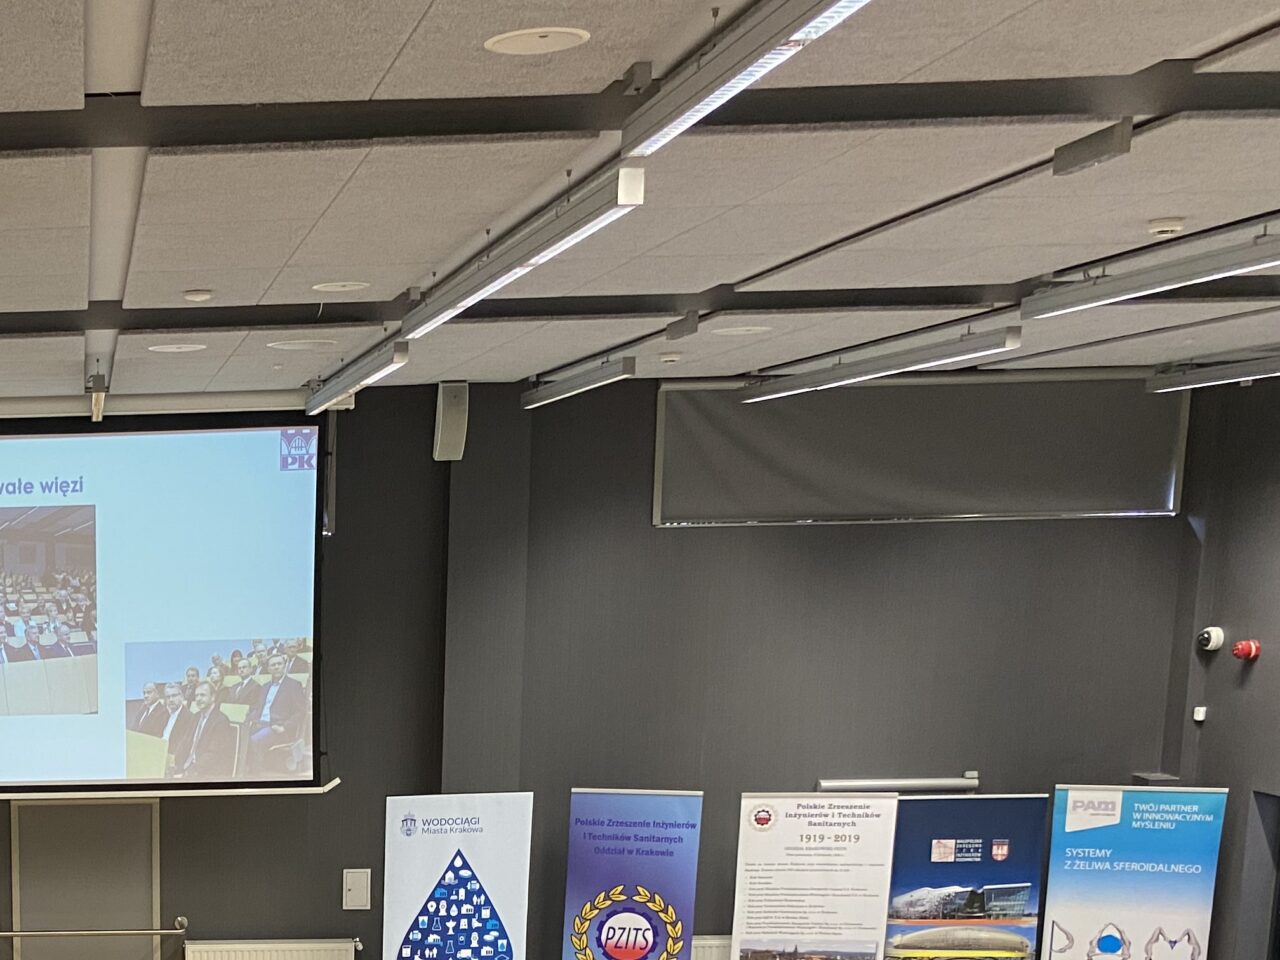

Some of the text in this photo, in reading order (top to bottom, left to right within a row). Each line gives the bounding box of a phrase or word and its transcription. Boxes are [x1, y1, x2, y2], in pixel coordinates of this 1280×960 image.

[281, 453, 316, 469] PK
[39, 476, 84, 497] więzi
[1133, 803, 1199, 813] TWÓJ PARTNER
[421, 816, 480, 827] WODOCIĄGI
[1133, 812, 1214, 822] W INNOWACYJNYM
[574, 817, 697, 830] Polskie Zrzeszenie Inżynierów
[1132, 820, 1176, 830] MYŚLENIU
[421, 826, 484, 835] Miasta Krakowa
[588, 832, 632, 841] Techników
[633, 834, 684, 845] Sanitarnych
[799, 834, 825, 843] 1919
[833, 834, 860, 843] 2019
[635, 847, 675, 857] Krakowie
[1065, 848, 1113, 858] SYSTEMY
[1064, 860, 1202, 874] Z ŻELIWA SFEROIDALNEGO
[604, 926, 651, 950] PZITS
